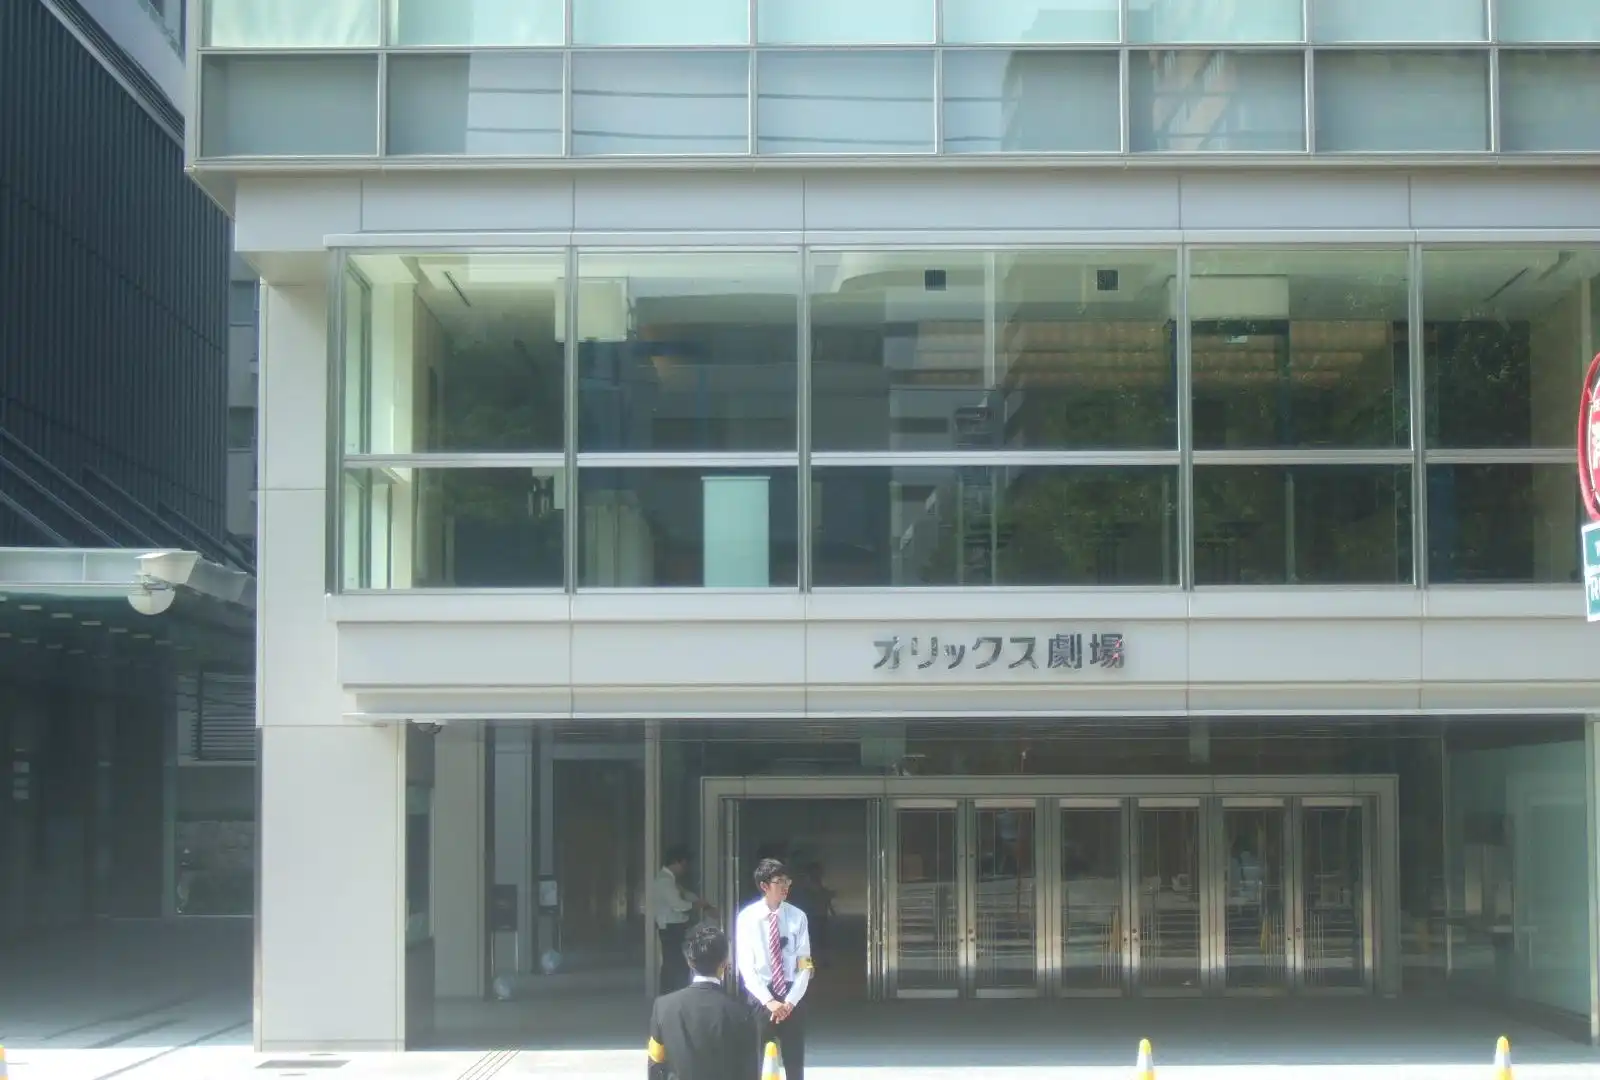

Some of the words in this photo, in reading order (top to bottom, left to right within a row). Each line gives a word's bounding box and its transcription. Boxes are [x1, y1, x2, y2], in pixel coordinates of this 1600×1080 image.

[873, 633, 1125, 670] オリックス劇場
